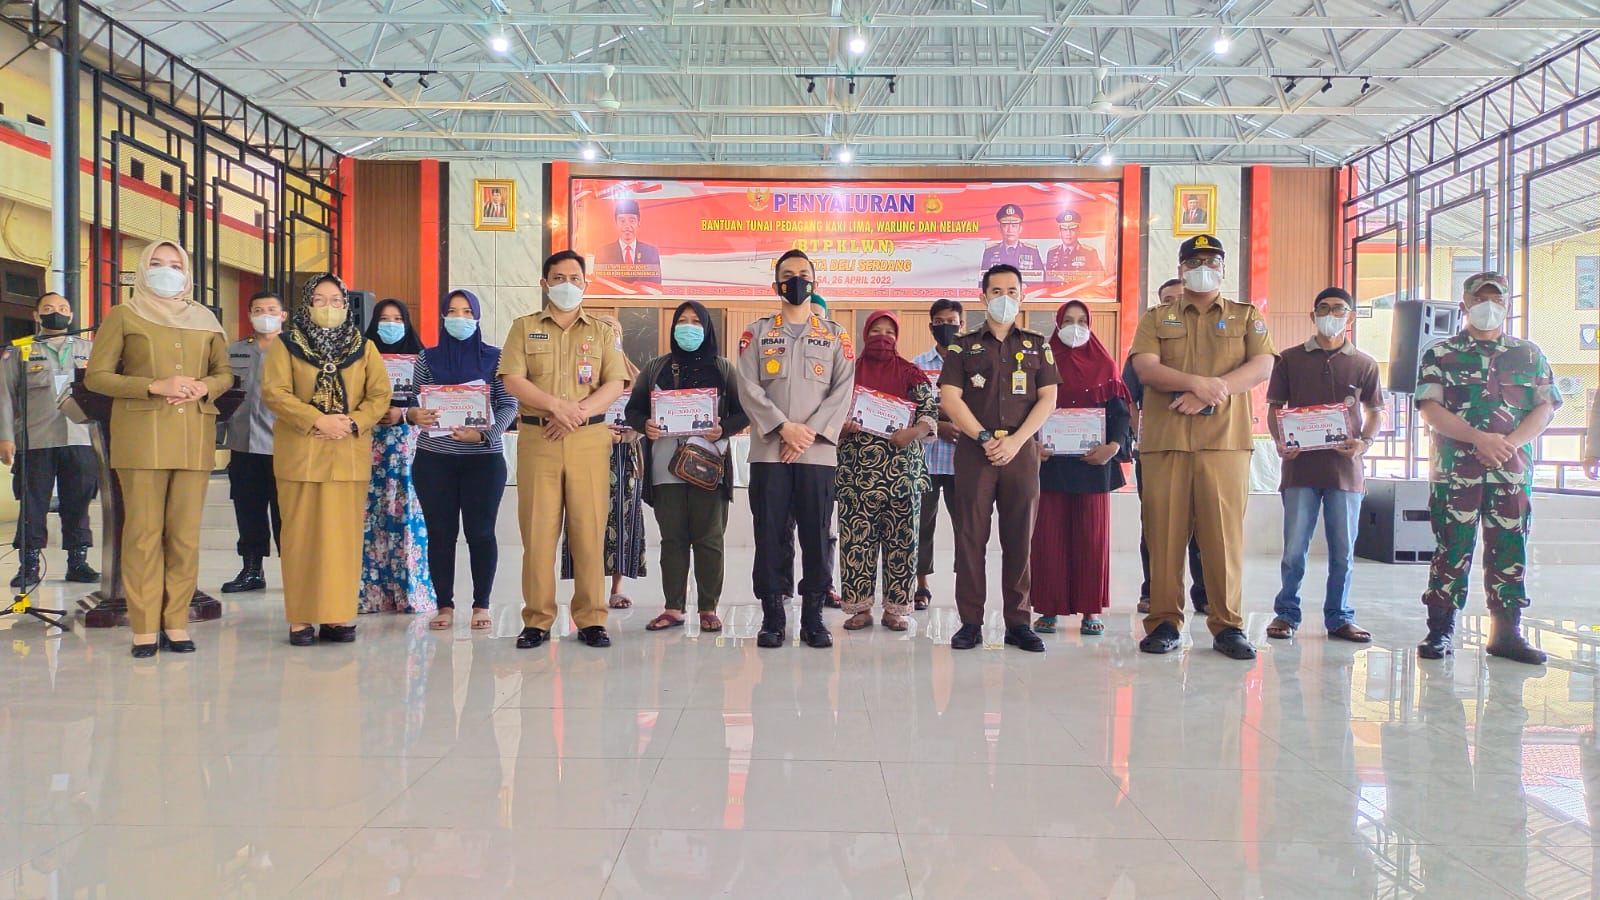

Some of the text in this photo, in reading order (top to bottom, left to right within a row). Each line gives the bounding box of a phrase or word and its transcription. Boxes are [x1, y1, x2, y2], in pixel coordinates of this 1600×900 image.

[773, 193, 916, 213] PENYALURAN
[702, 219, 979, 233] BANTUAN TUNAI PEDAGANG KAKI LIMA, WARUNG DAN NELAYAN
[830, 259, 856, 272] DELI
[857, 259, 913, 272] SERDANG
[831, 276, 843, 285] 26
[844, 276, 869, 285] APRIL
[870, 276, 892, 285] 2022
[761, 338, 785, 346] IRSAN
[807, 338, 831, 348] POLRI
